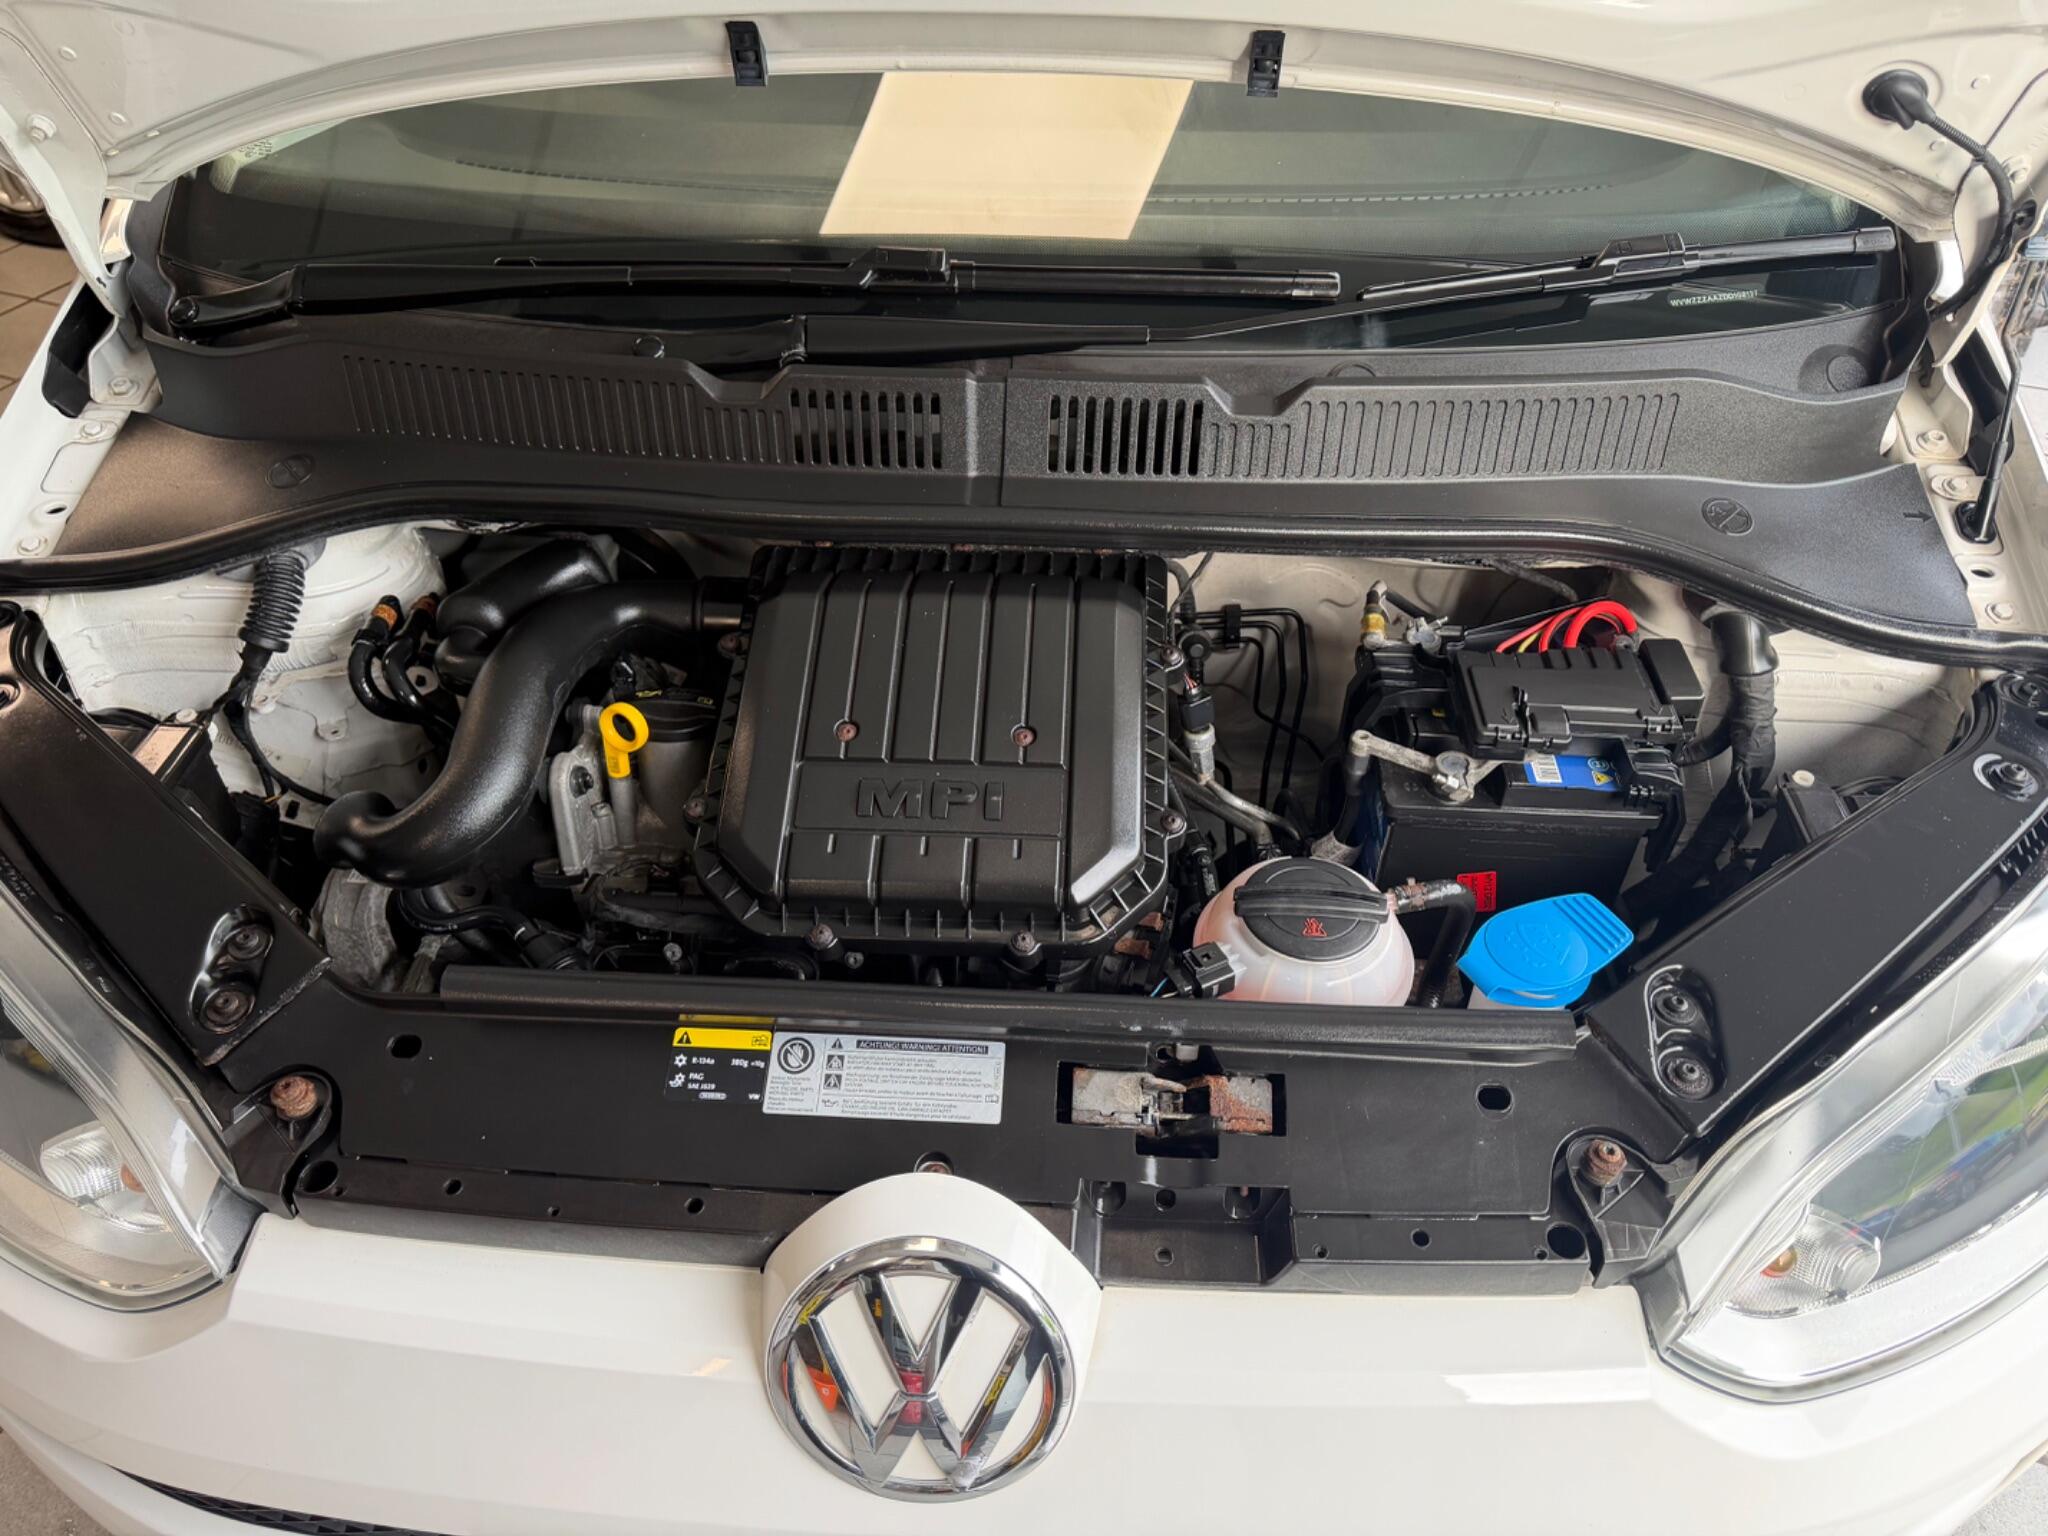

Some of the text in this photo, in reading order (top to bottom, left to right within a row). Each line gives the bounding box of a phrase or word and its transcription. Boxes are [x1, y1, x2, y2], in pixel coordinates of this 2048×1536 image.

[856, 778, 1005, 821] MPI
[689, 1072, 705, 1081] PAG
[687, 1082, 700, 1090] SAE
